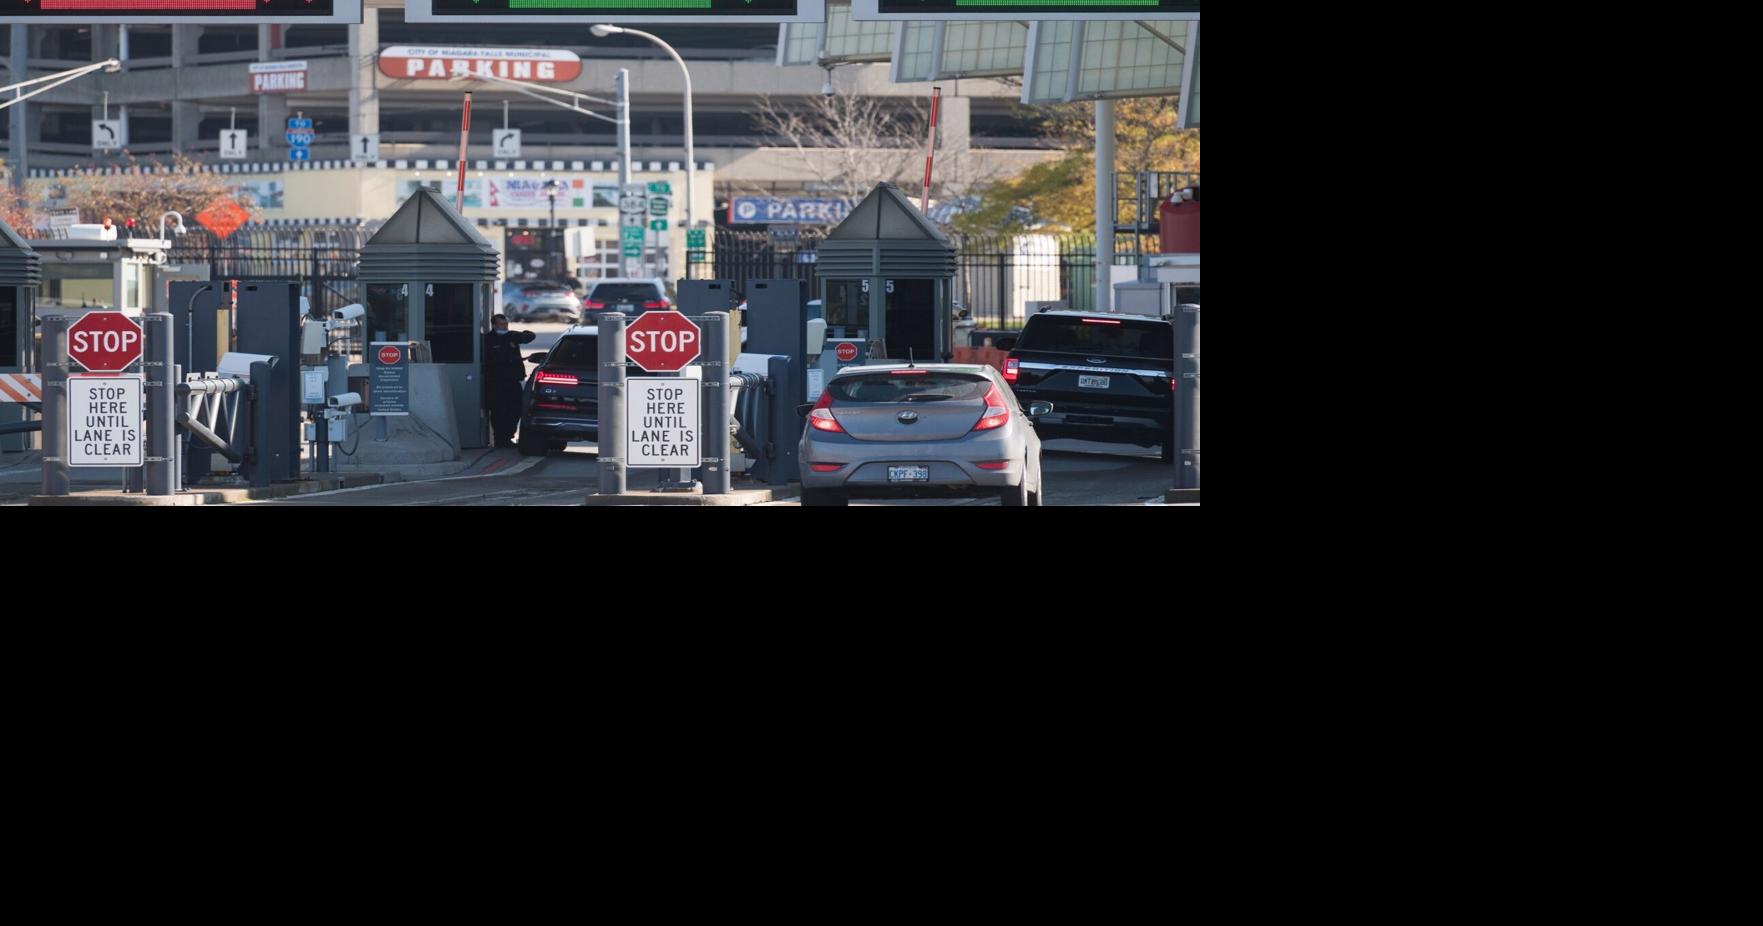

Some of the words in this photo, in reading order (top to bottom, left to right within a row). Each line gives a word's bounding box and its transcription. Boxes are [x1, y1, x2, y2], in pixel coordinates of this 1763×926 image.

[406, 58, 555, 79] PARKING
[253, 71, 305, 91] PARKING
[291, 134, 311, 143] 190
[767, 201, 847, 218] PARKI
[401, 284, 408, 297] 4
[425, 284, 433, 297] 4
[862, 280, 869, 293] 5
[886, 280, 894, 293] 5
[73, 331, 137, 352] STOP
[630, 331, 695, 352] STOP
[89, 388, 125, 400] STOP
[647, 389, 683, 400] STOP
[89, 402, 127, 414] HERE
[647, 403, 685, 414] HERE
[86, 416, 129, 428] UNTIL
[643, 417, 687, 428] UNTIL
[75, 430, 112, 441] LANE
[123, 430, 135, 441] IS
[632, 431, 670, 442] LANE
[680, 431, 694, 442] IS
[85, 444, 131, 456] CLEAR
[642, 445, 688, 456] CLEAR
